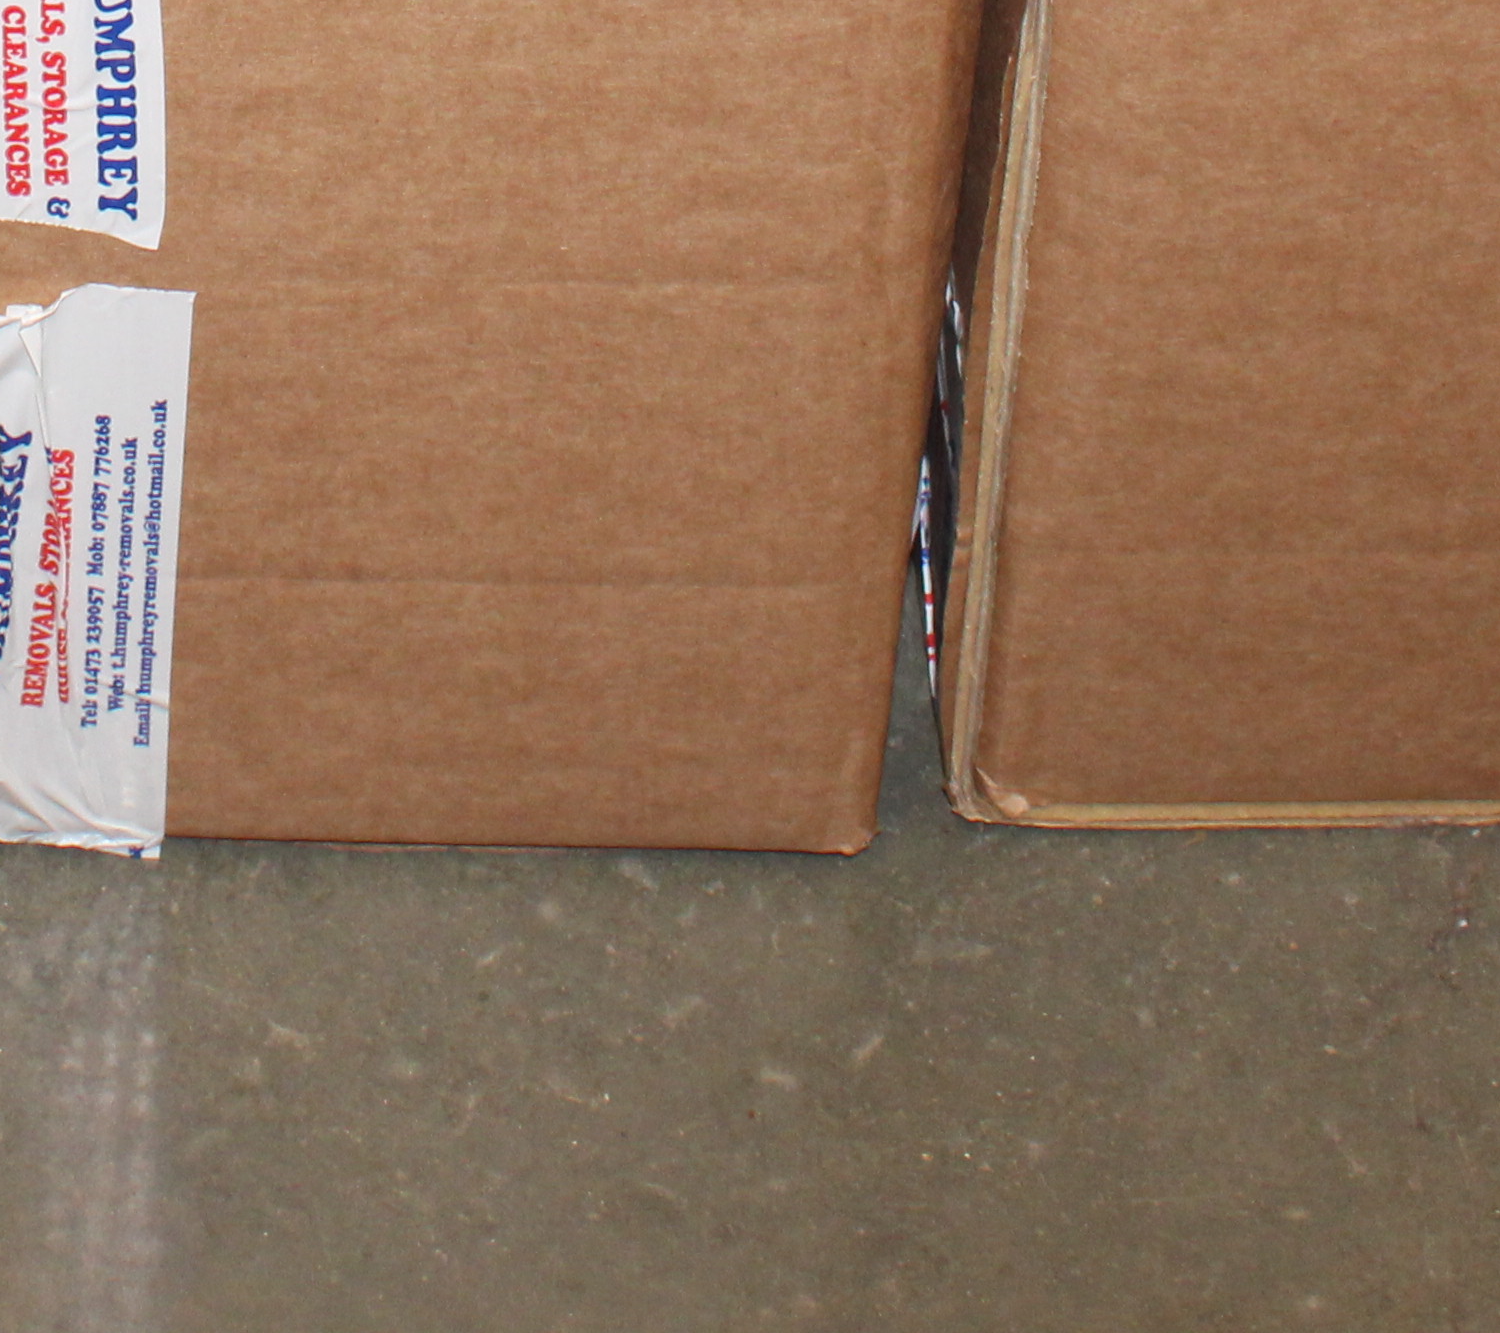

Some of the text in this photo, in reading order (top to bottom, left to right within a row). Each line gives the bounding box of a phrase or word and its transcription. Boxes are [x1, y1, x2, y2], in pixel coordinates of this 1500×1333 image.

[1, 4, 32, 198] CLEARANCES
[40, 51, 69, 186] STORAGE
[46, 197, 71, 218] &
[87, 414, 113, 701] 01473 239057 Mob: 07887 776268
[107, 675, 124, 713] Web:
